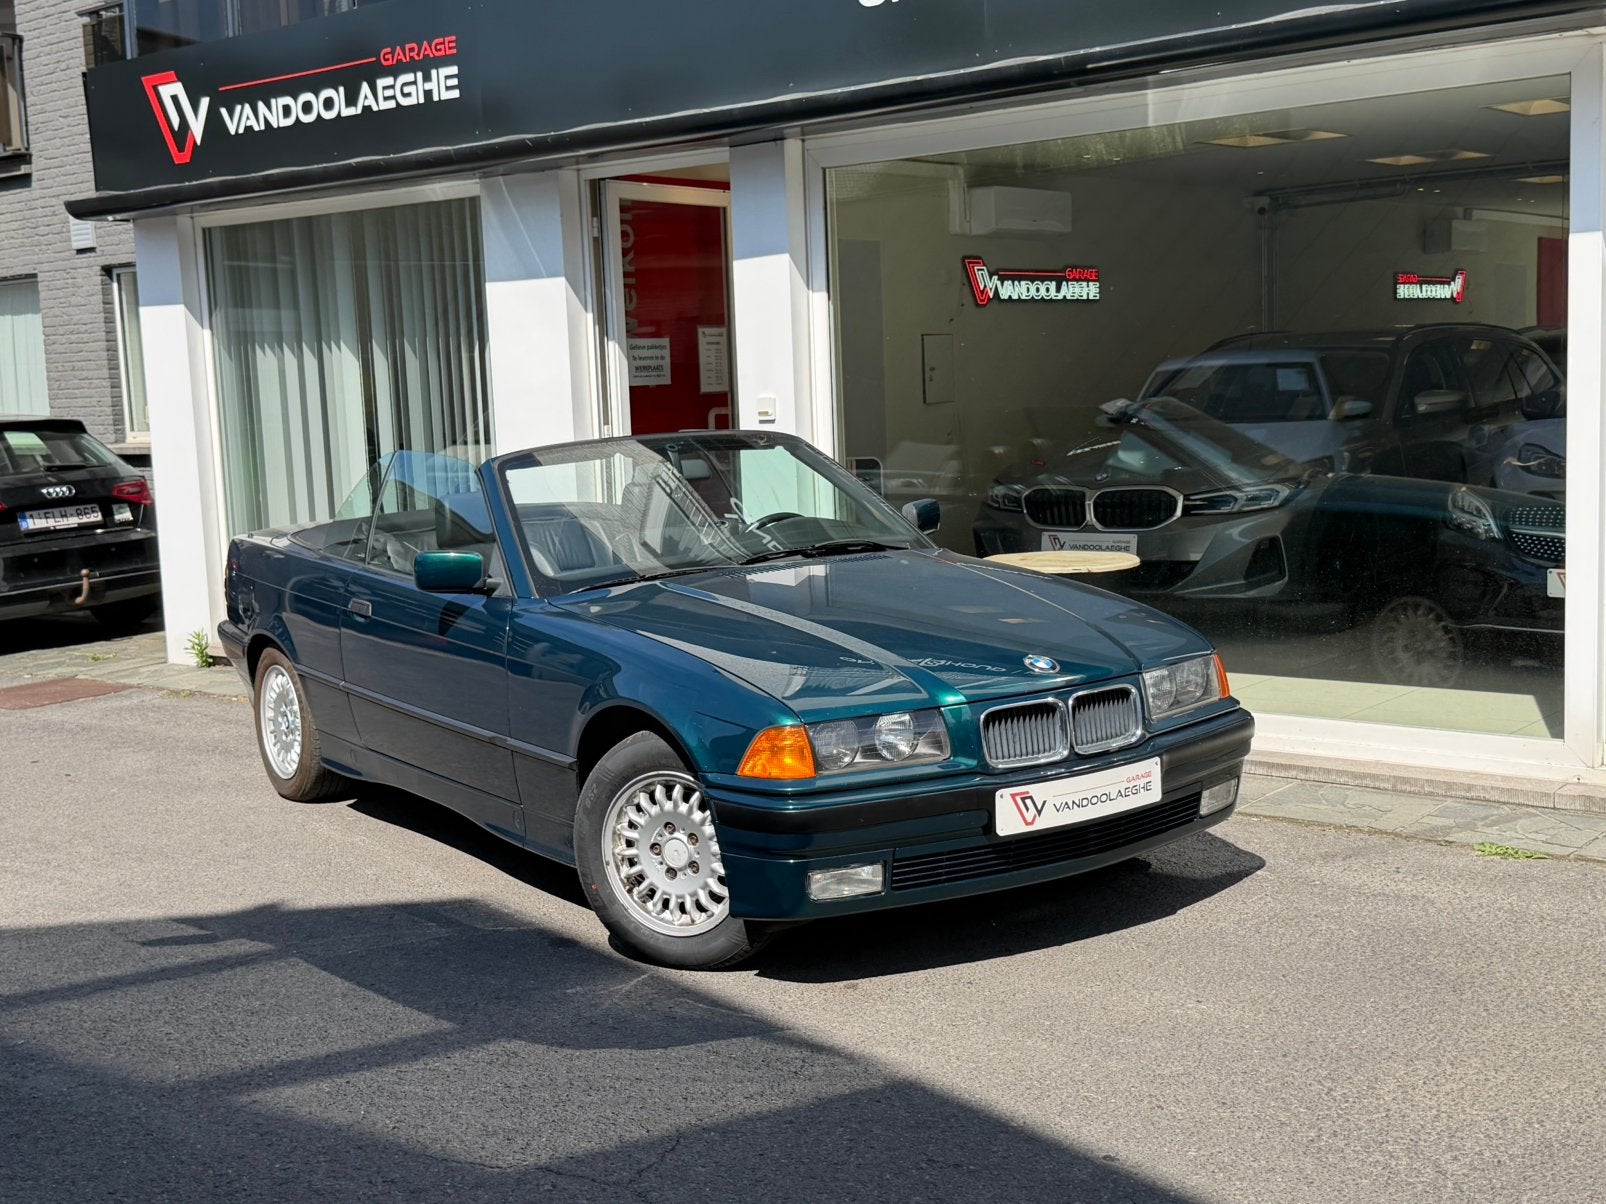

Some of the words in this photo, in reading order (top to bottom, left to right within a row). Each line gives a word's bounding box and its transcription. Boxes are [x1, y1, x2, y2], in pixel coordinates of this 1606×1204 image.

[380, 36, 457, 66] GARAGE
[219, 65, 460, 136] VANDOOLAEGHE
[1065, 268, 1099, 280] GARAGE
[996, 280, 1100, 300] VANDOOLAEGHE
[1068, 543, 1131, 552] VANDOOLAEGHE
[1125, 770, 1153, 784] GARAGE
[1053, 781, 1153, 813] VANDOOLAEGHE
